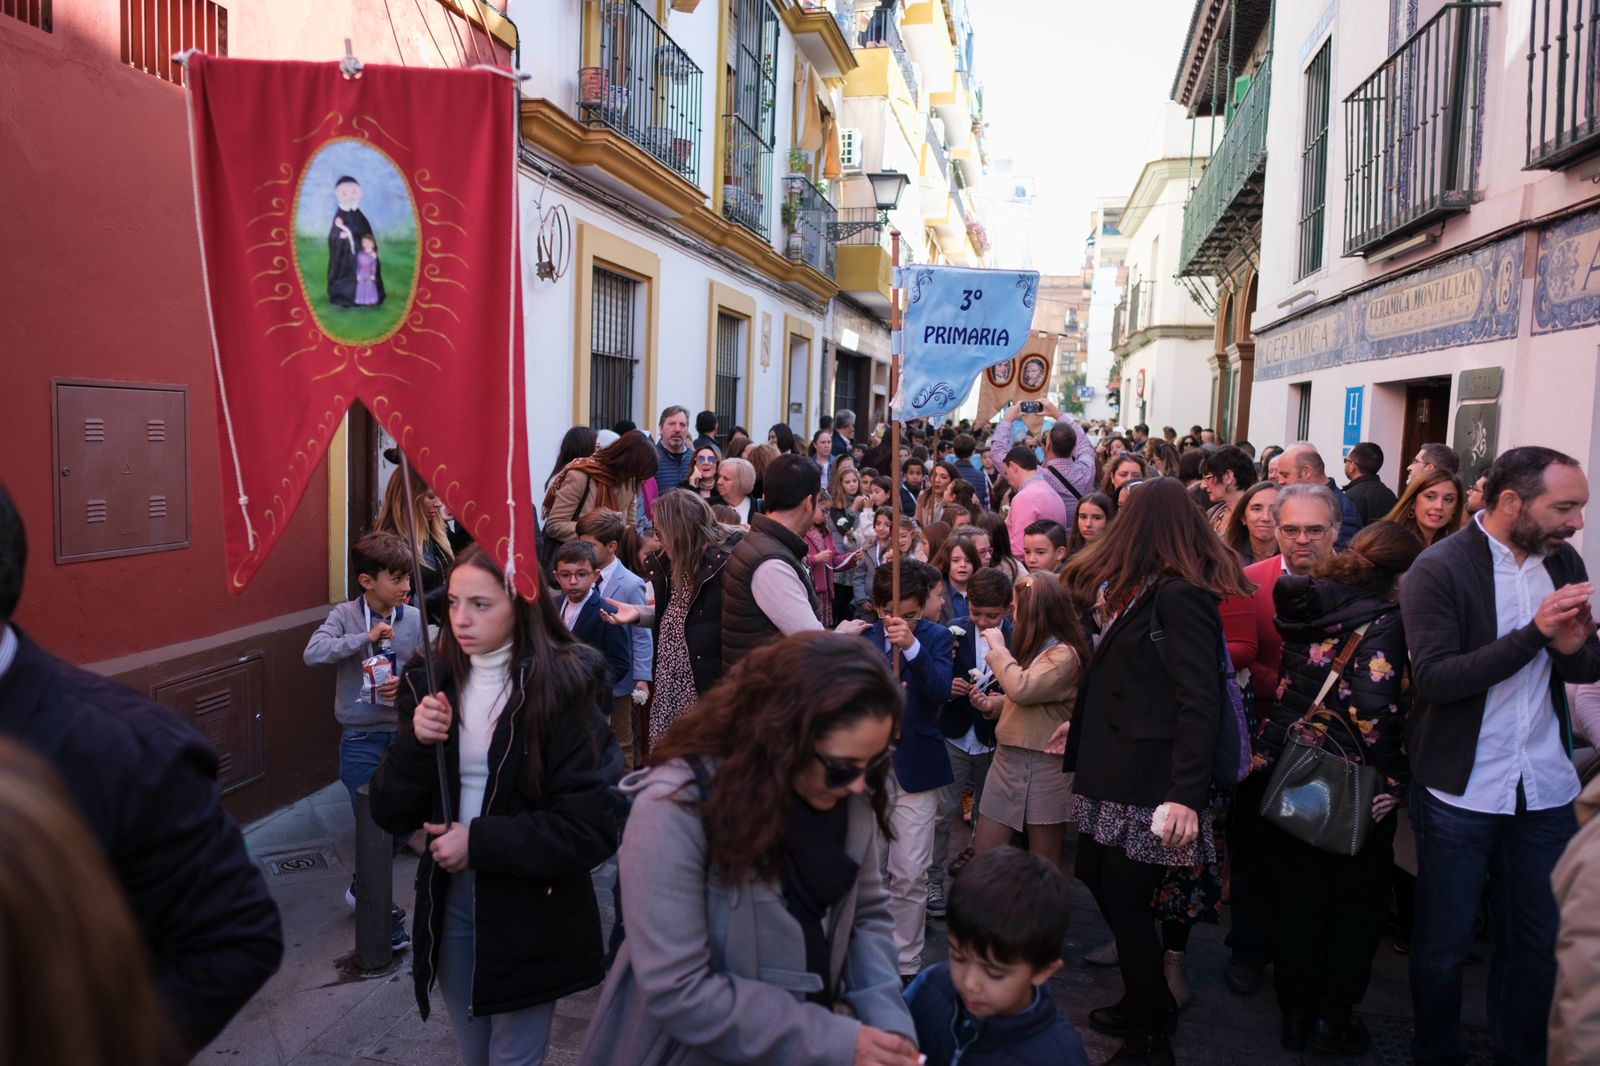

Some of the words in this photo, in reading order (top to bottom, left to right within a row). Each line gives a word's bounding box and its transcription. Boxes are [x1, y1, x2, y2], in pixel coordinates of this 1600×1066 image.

[1497, 260, 1514, 307] 13
[960, 289, 983, 311] 3º
[1369, 292, 1410, 320] CERAMICA
[924, 326, 1009, 346] PRIMARIA
[1265, 321, 1329, 364] CERAMICA
[1348, 393, 1360, 426] H
